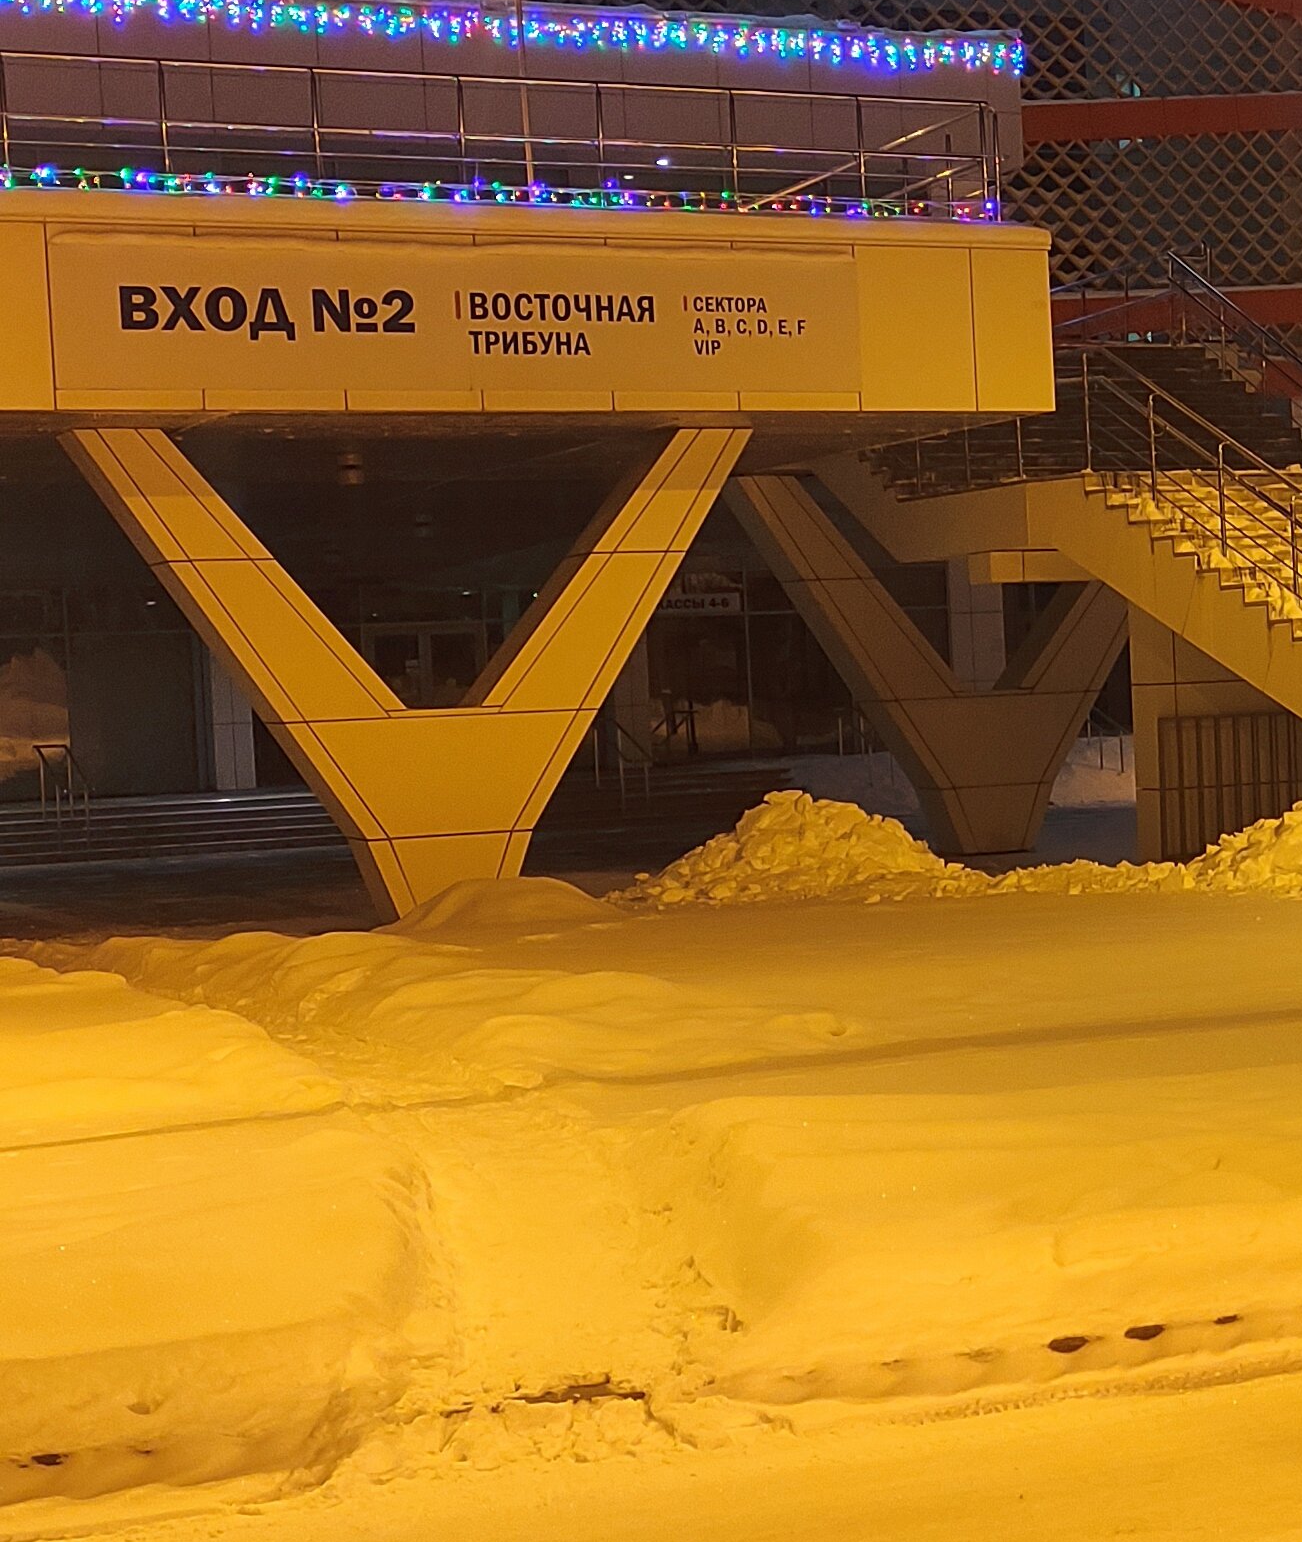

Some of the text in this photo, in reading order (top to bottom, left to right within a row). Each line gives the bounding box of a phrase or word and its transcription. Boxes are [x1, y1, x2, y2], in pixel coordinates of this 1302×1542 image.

[118, 285, 416, 341] ВХОД №2
[468, 292, 655, 323] ВОСТОЧНАЯ
[693, 296, 768, 313] СЕКТОРА
[797, 320, 806, 335] F
[468, 330, 591, 356] ТРИБУНА
[694, 339, 721, 355] VIP
